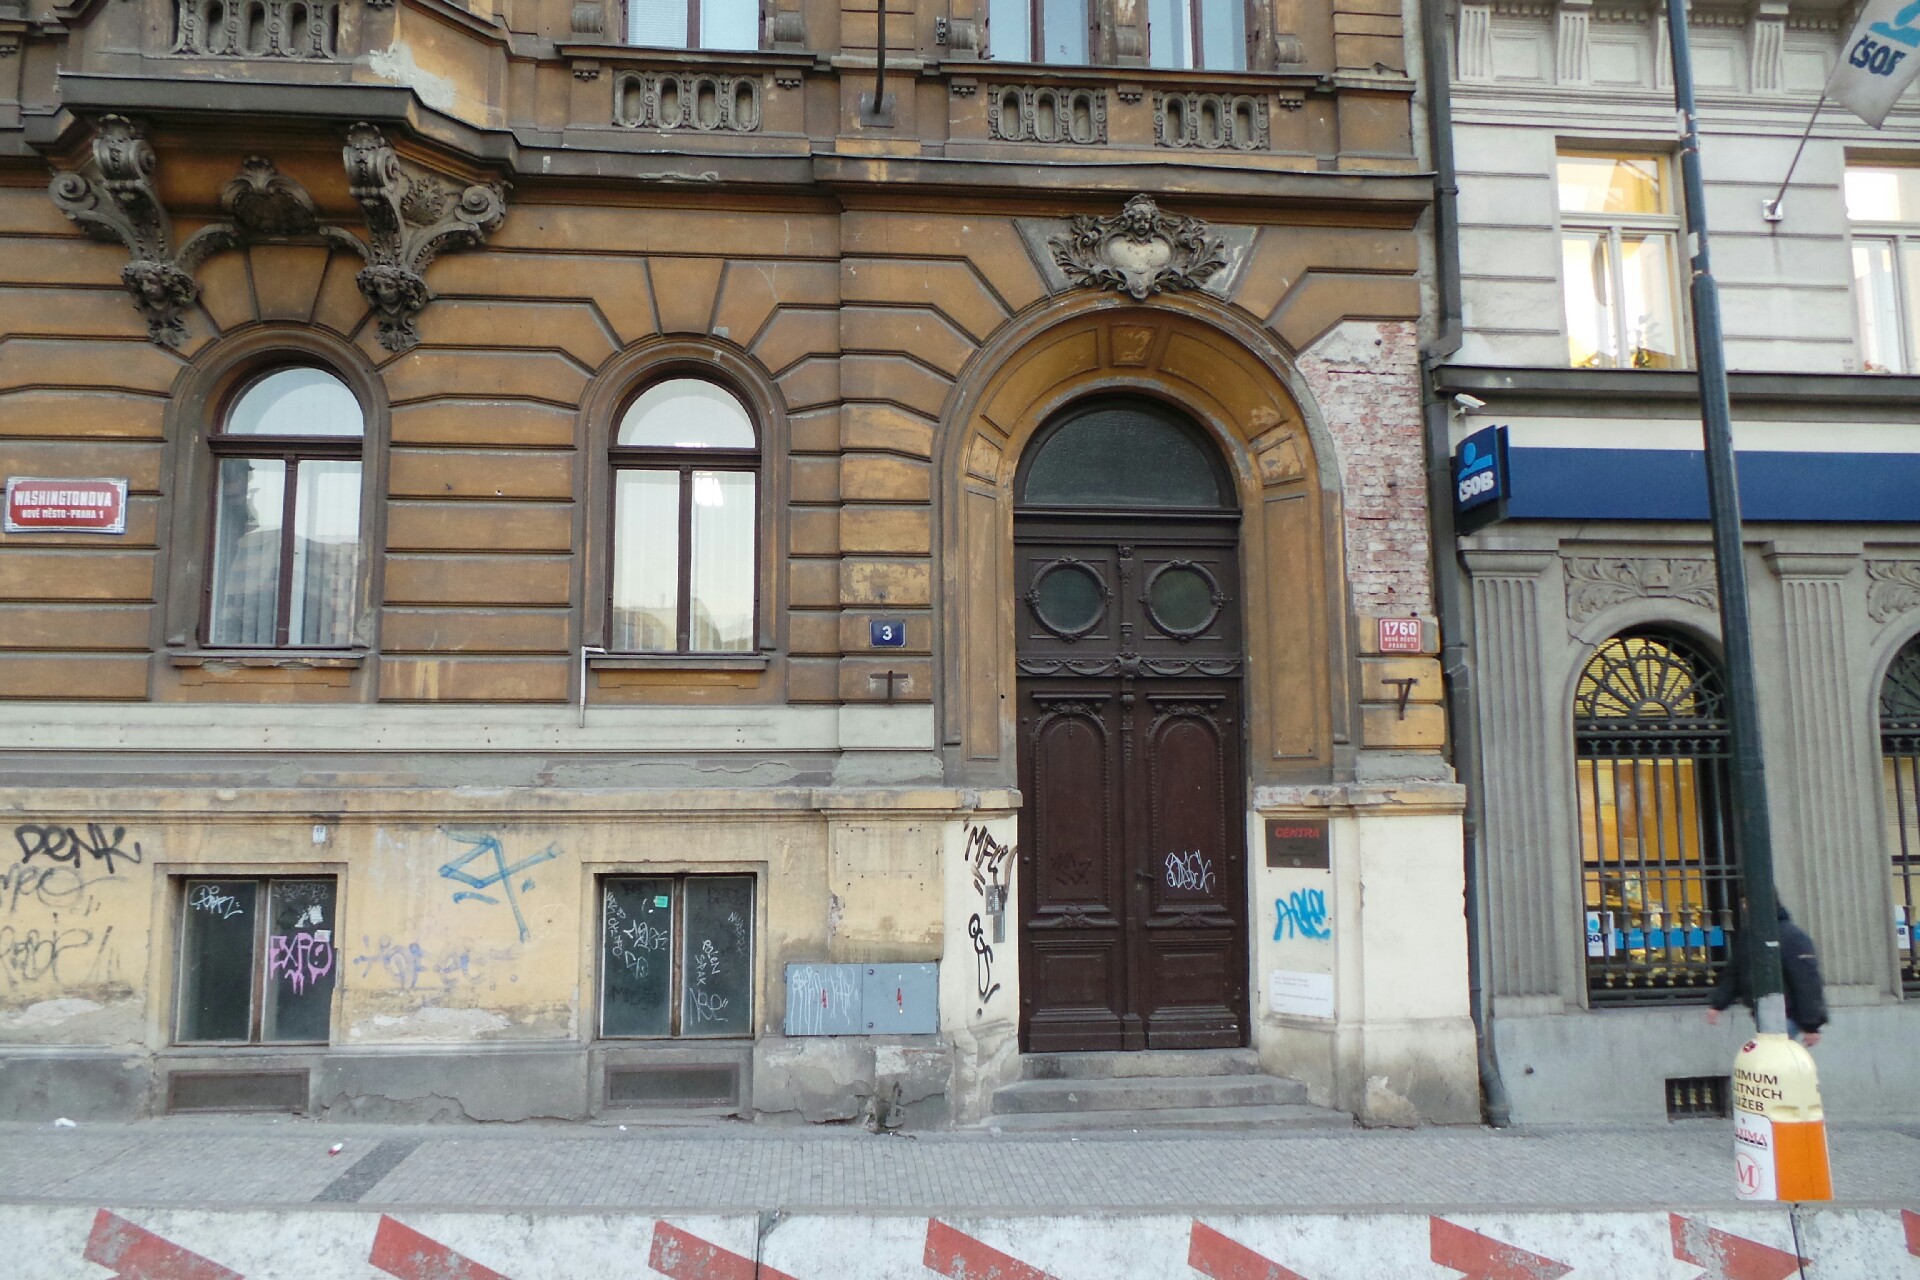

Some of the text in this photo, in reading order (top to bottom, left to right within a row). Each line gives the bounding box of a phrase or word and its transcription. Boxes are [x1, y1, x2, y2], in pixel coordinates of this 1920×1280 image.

[15, 490, 112, 507] WASHINGTONOVA
[22, 508, 41, 519] NOVÉ
[42, 507, 66, 519] MĚSTO
[70, 509, 97, 519] PRAHA
[98, 510, 104, 519] 1
[882, 625, 893, 641] 3
[1384, 621, 1417, 636] 1760
